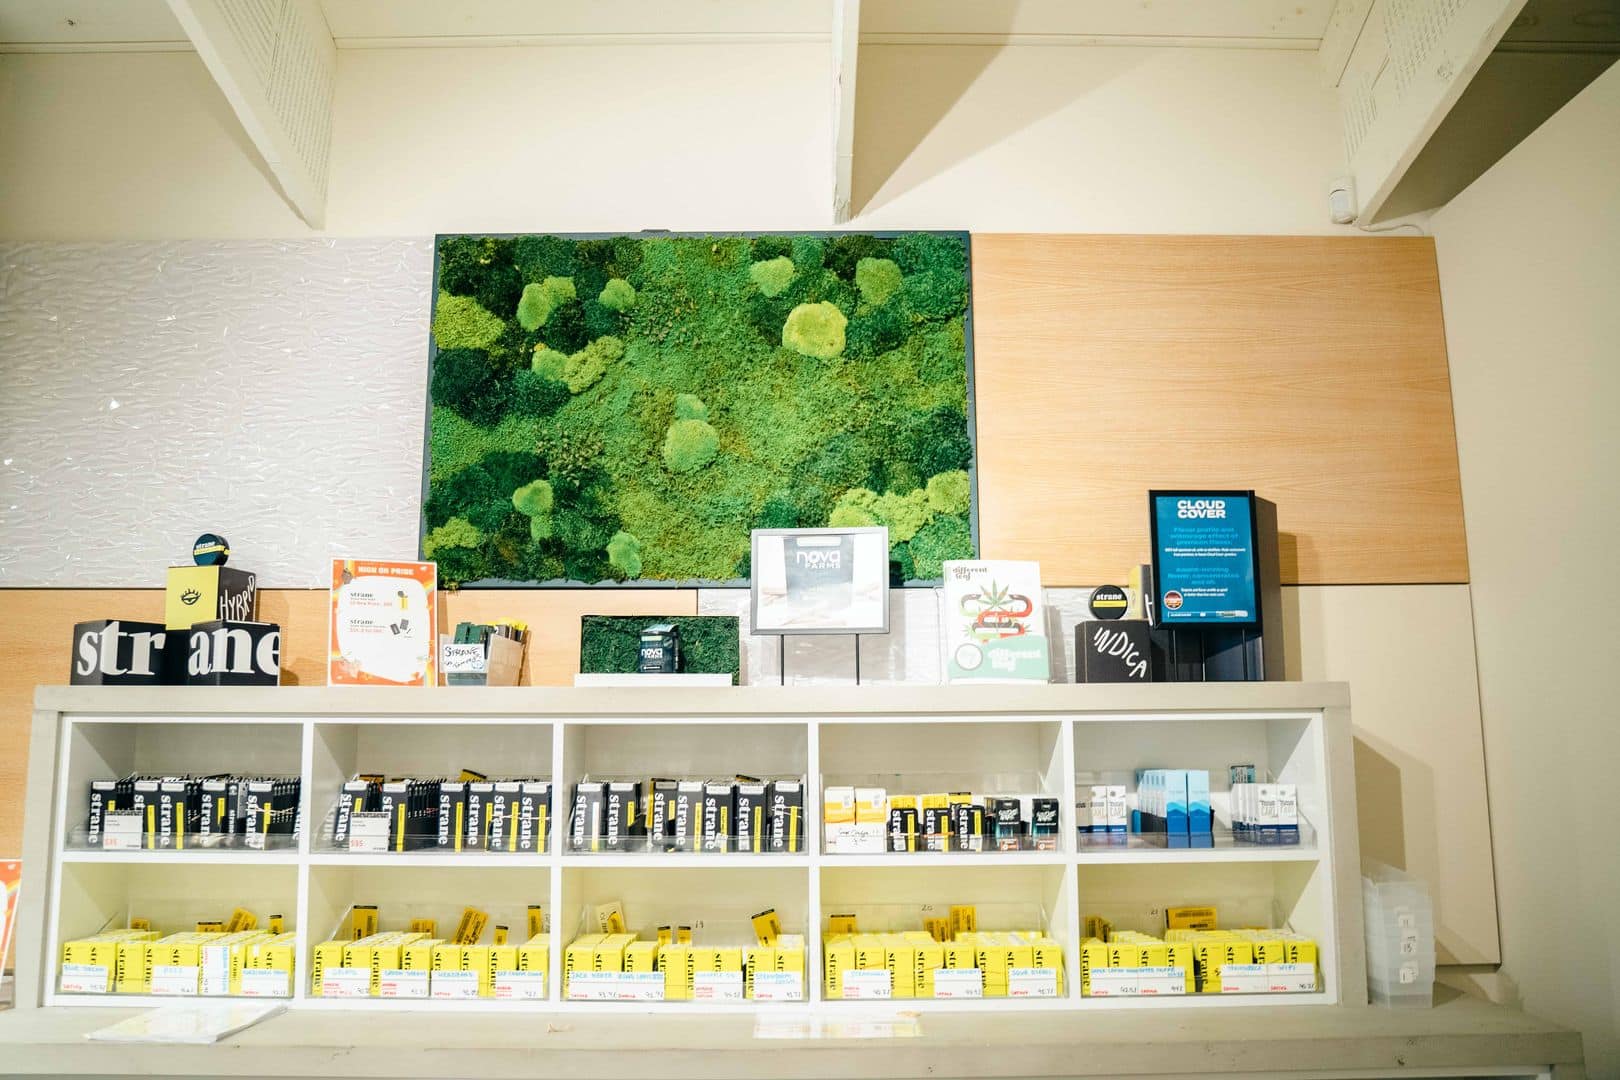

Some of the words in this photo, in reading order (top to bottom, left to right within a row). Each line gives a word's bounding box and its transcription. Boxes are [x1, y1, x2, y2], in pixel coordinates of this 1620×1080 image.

[1177, 500, 1225, 509] CLOUD
[1177, 509, 1226, 519] COVER
[796, 550, 841, 564] nova
[952, 567, 988, 575] different
[219, 575, 255, 622] HYBRID
[641, 648, 663, 656] nova
[1093, 626, 1147, 678] INDICA
[88, 793, 103, 844] strane
[160, 794, 173, 846] strane
[335, 793, 353, 841] strane
[438, 794, 451, 845] strane
[468, 794, 480, 845] strane
[491, 794, 505, 847] strane
[520, 797, 534, 849] strane
[573, 795, 587, 845] strane
[608, 794, 621, 845] strane
[653, 792, 666, 841] strane
[676, 795, 689, 846] strane
[705, 797, 718, 850] strane
[773, 794, 786, 848] strane
[959, 809, 970, 849] strane
[1082, 949, 1090, 986] strane
